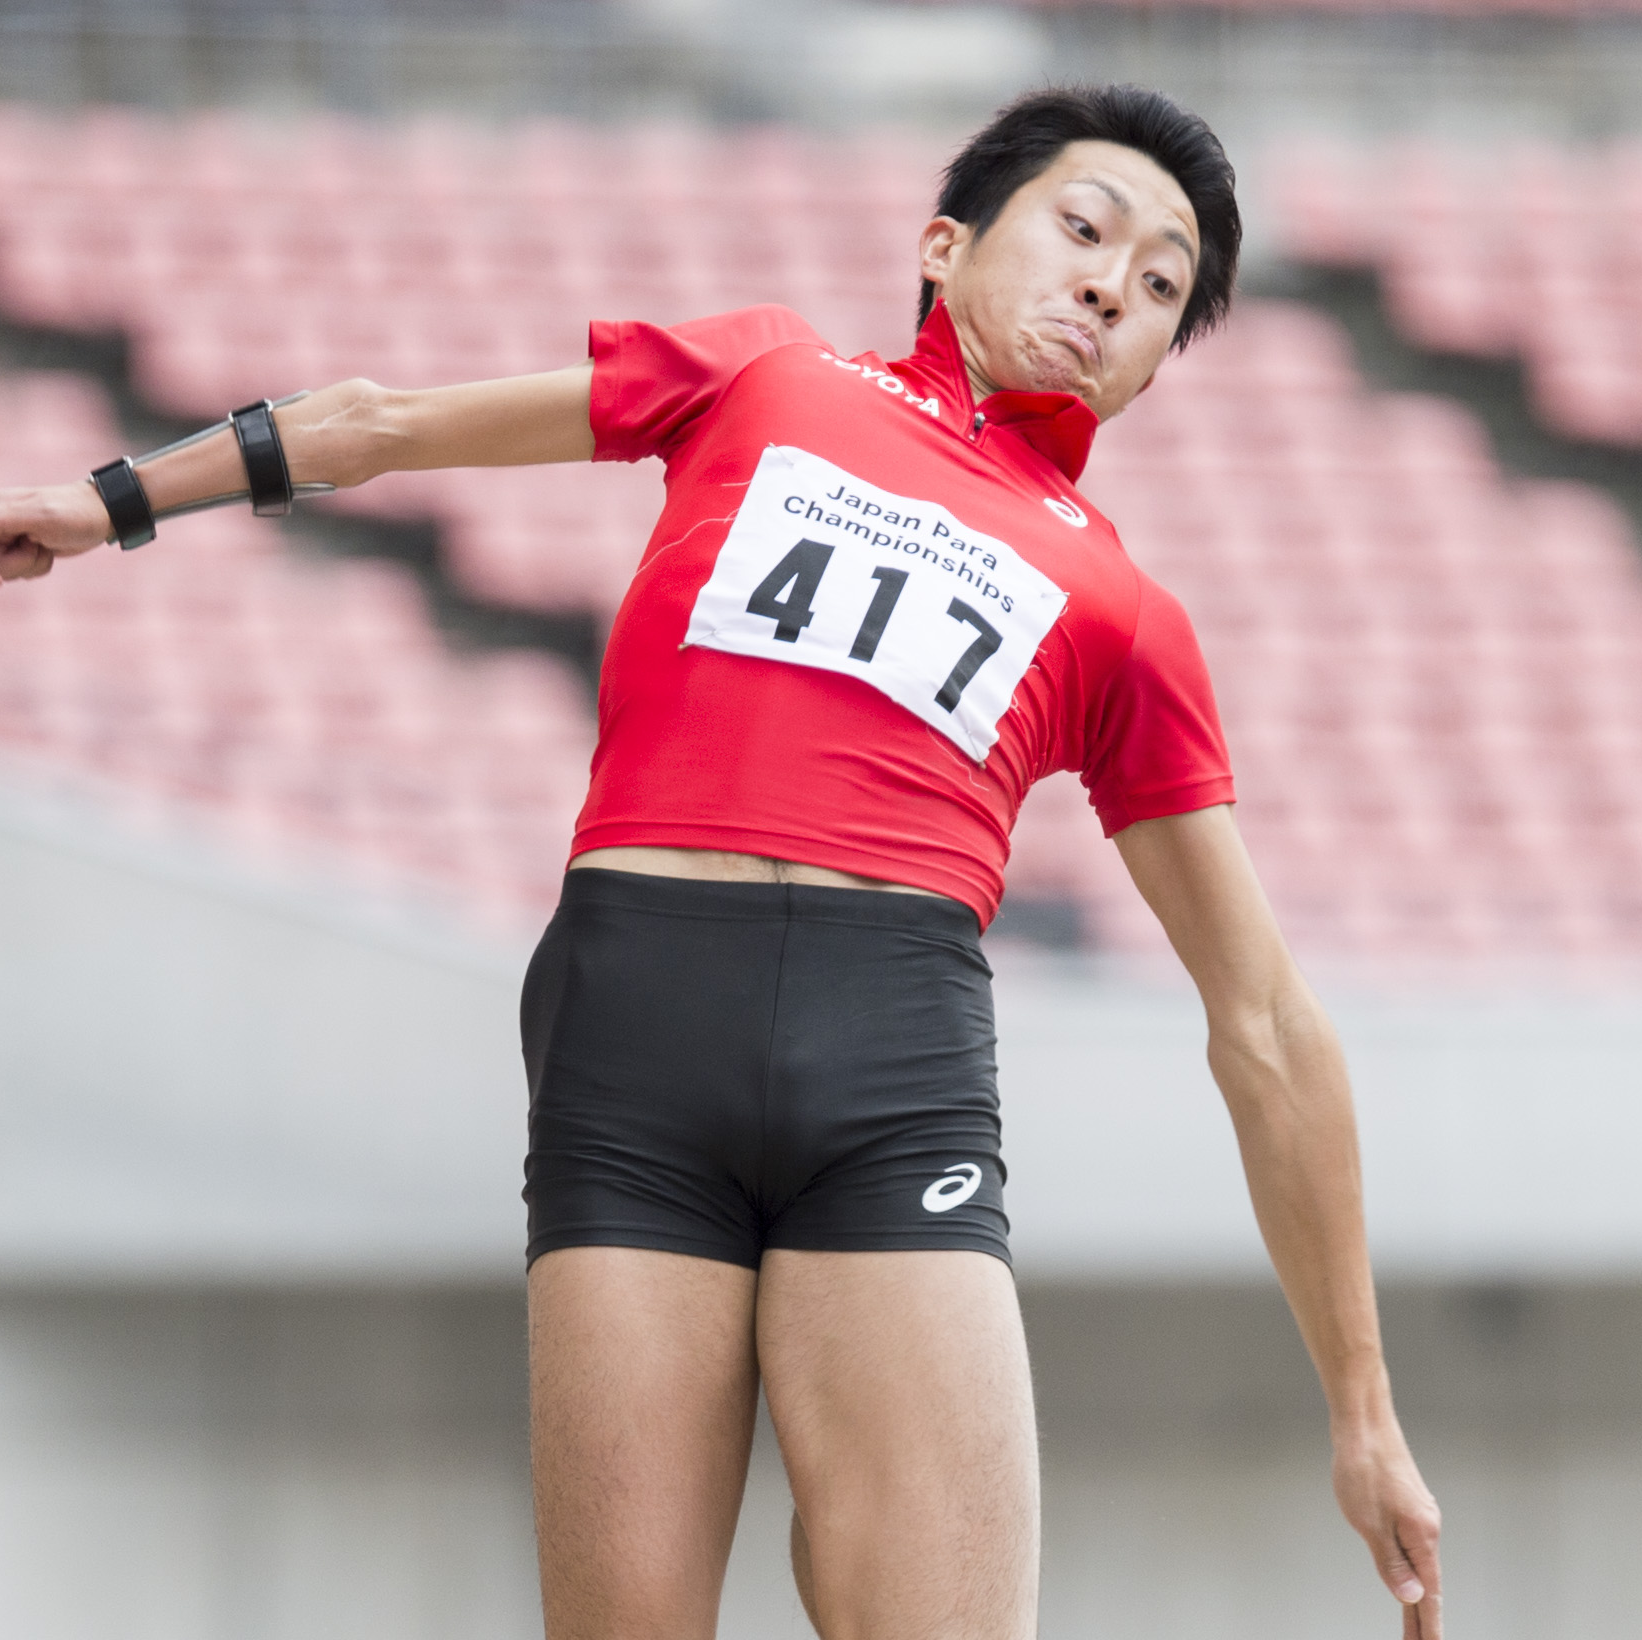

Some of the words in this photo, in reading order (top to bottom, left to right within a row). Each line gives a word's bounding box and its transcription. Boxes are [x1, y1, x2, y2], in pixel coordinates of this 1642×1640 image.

[783, 495, 1015, 613] Championships
[826, 485, 921, 531] Japan
[932, 520, 998, 570] Para
[745, 537, 1004, 714] 417
